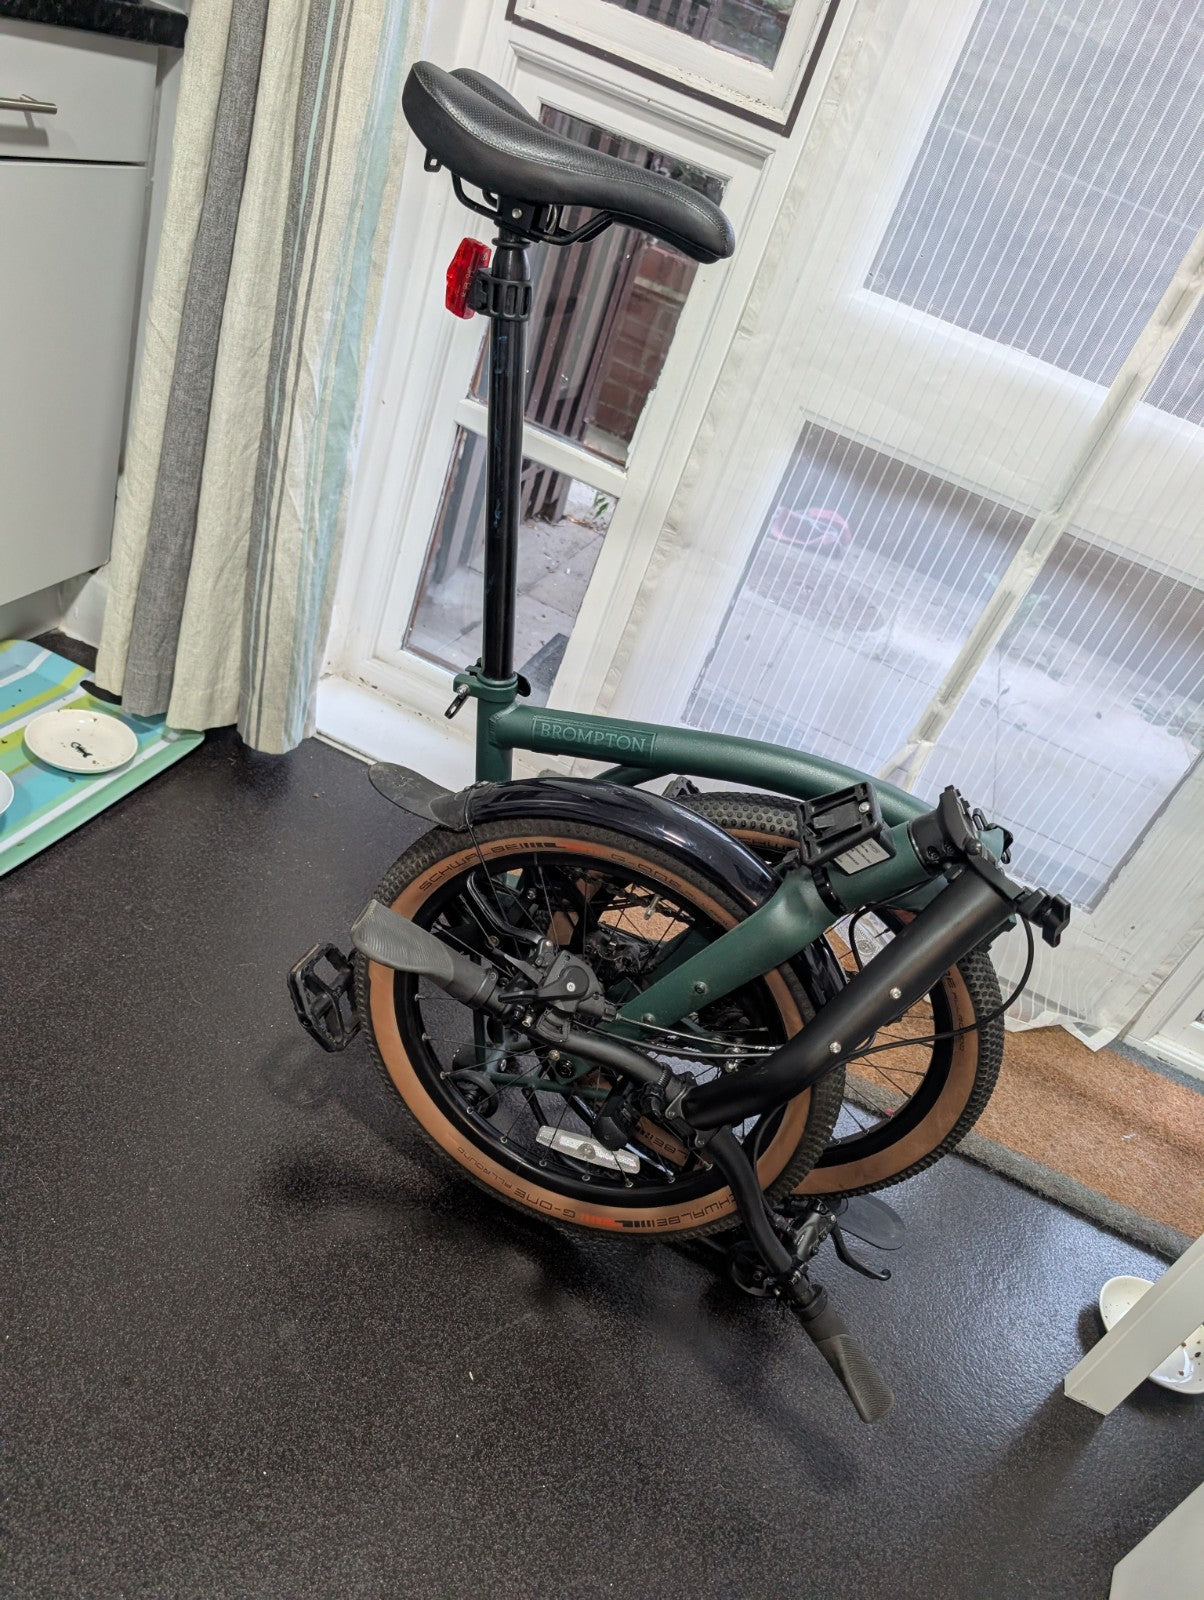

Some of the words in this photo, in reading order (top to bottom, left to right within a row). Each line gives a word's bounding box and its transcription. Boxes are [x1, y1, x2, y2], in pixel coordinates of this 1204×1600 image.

[541, 722, 646, 752] BROMPTON
[419, 843, 518, 891] SCHWALBE
[514, 1187, 576, 1219] G-ONE
[656, 1194, 735, 1227] CHWALBE
